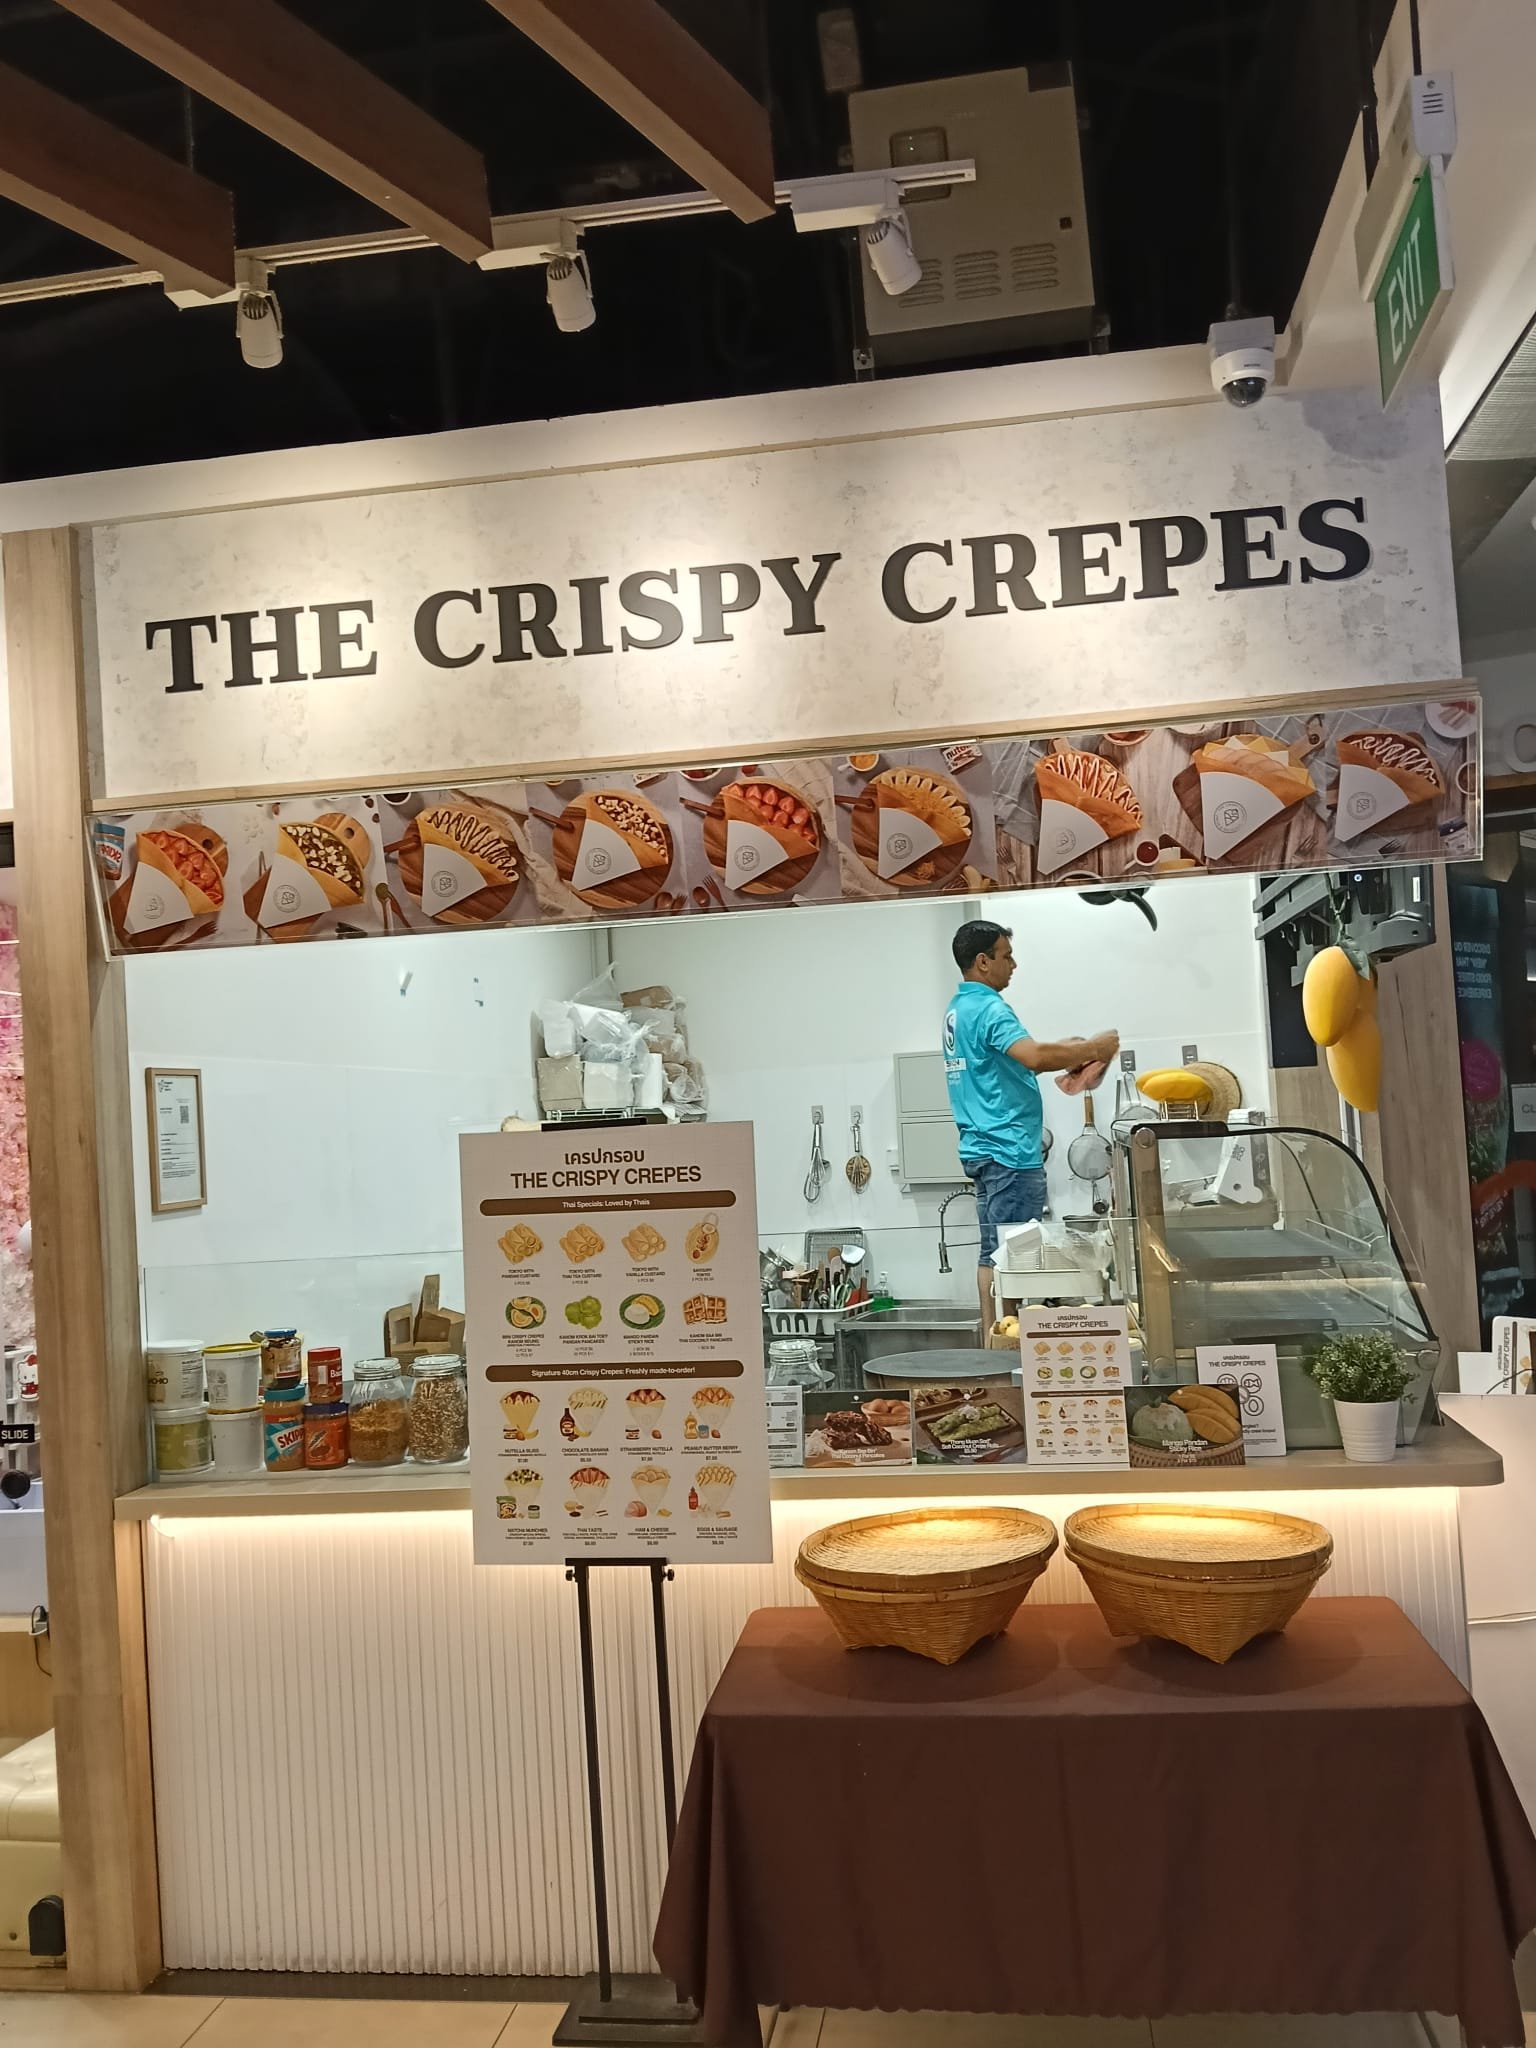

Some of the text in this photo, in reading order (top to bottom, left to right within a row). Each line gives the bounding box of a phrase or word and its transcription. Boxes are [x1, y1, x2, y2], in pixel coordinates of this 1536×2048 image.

[1387, 218, 1421, 365] EXIT
[145, 497, 1372, 693] THE CRISPY CREPES
[565, 1148, 645, 1165] เครปกรอบ
[510, 1166, 702, 1189] THE CRISPY CREPES
[624, 1200, 633, 1208] by
[1053, 1321, 1079, 1329] CRISPY
[1080, 1320, 1109, 1328] CREPES
[531, 1366, 696, 1378] Signature 40cm Crispy Crepes: Freshly made-to-order!
[1, 1429, 29, 1440] SLIDE
[1168, 1445, 1188, 1453] Sticky
